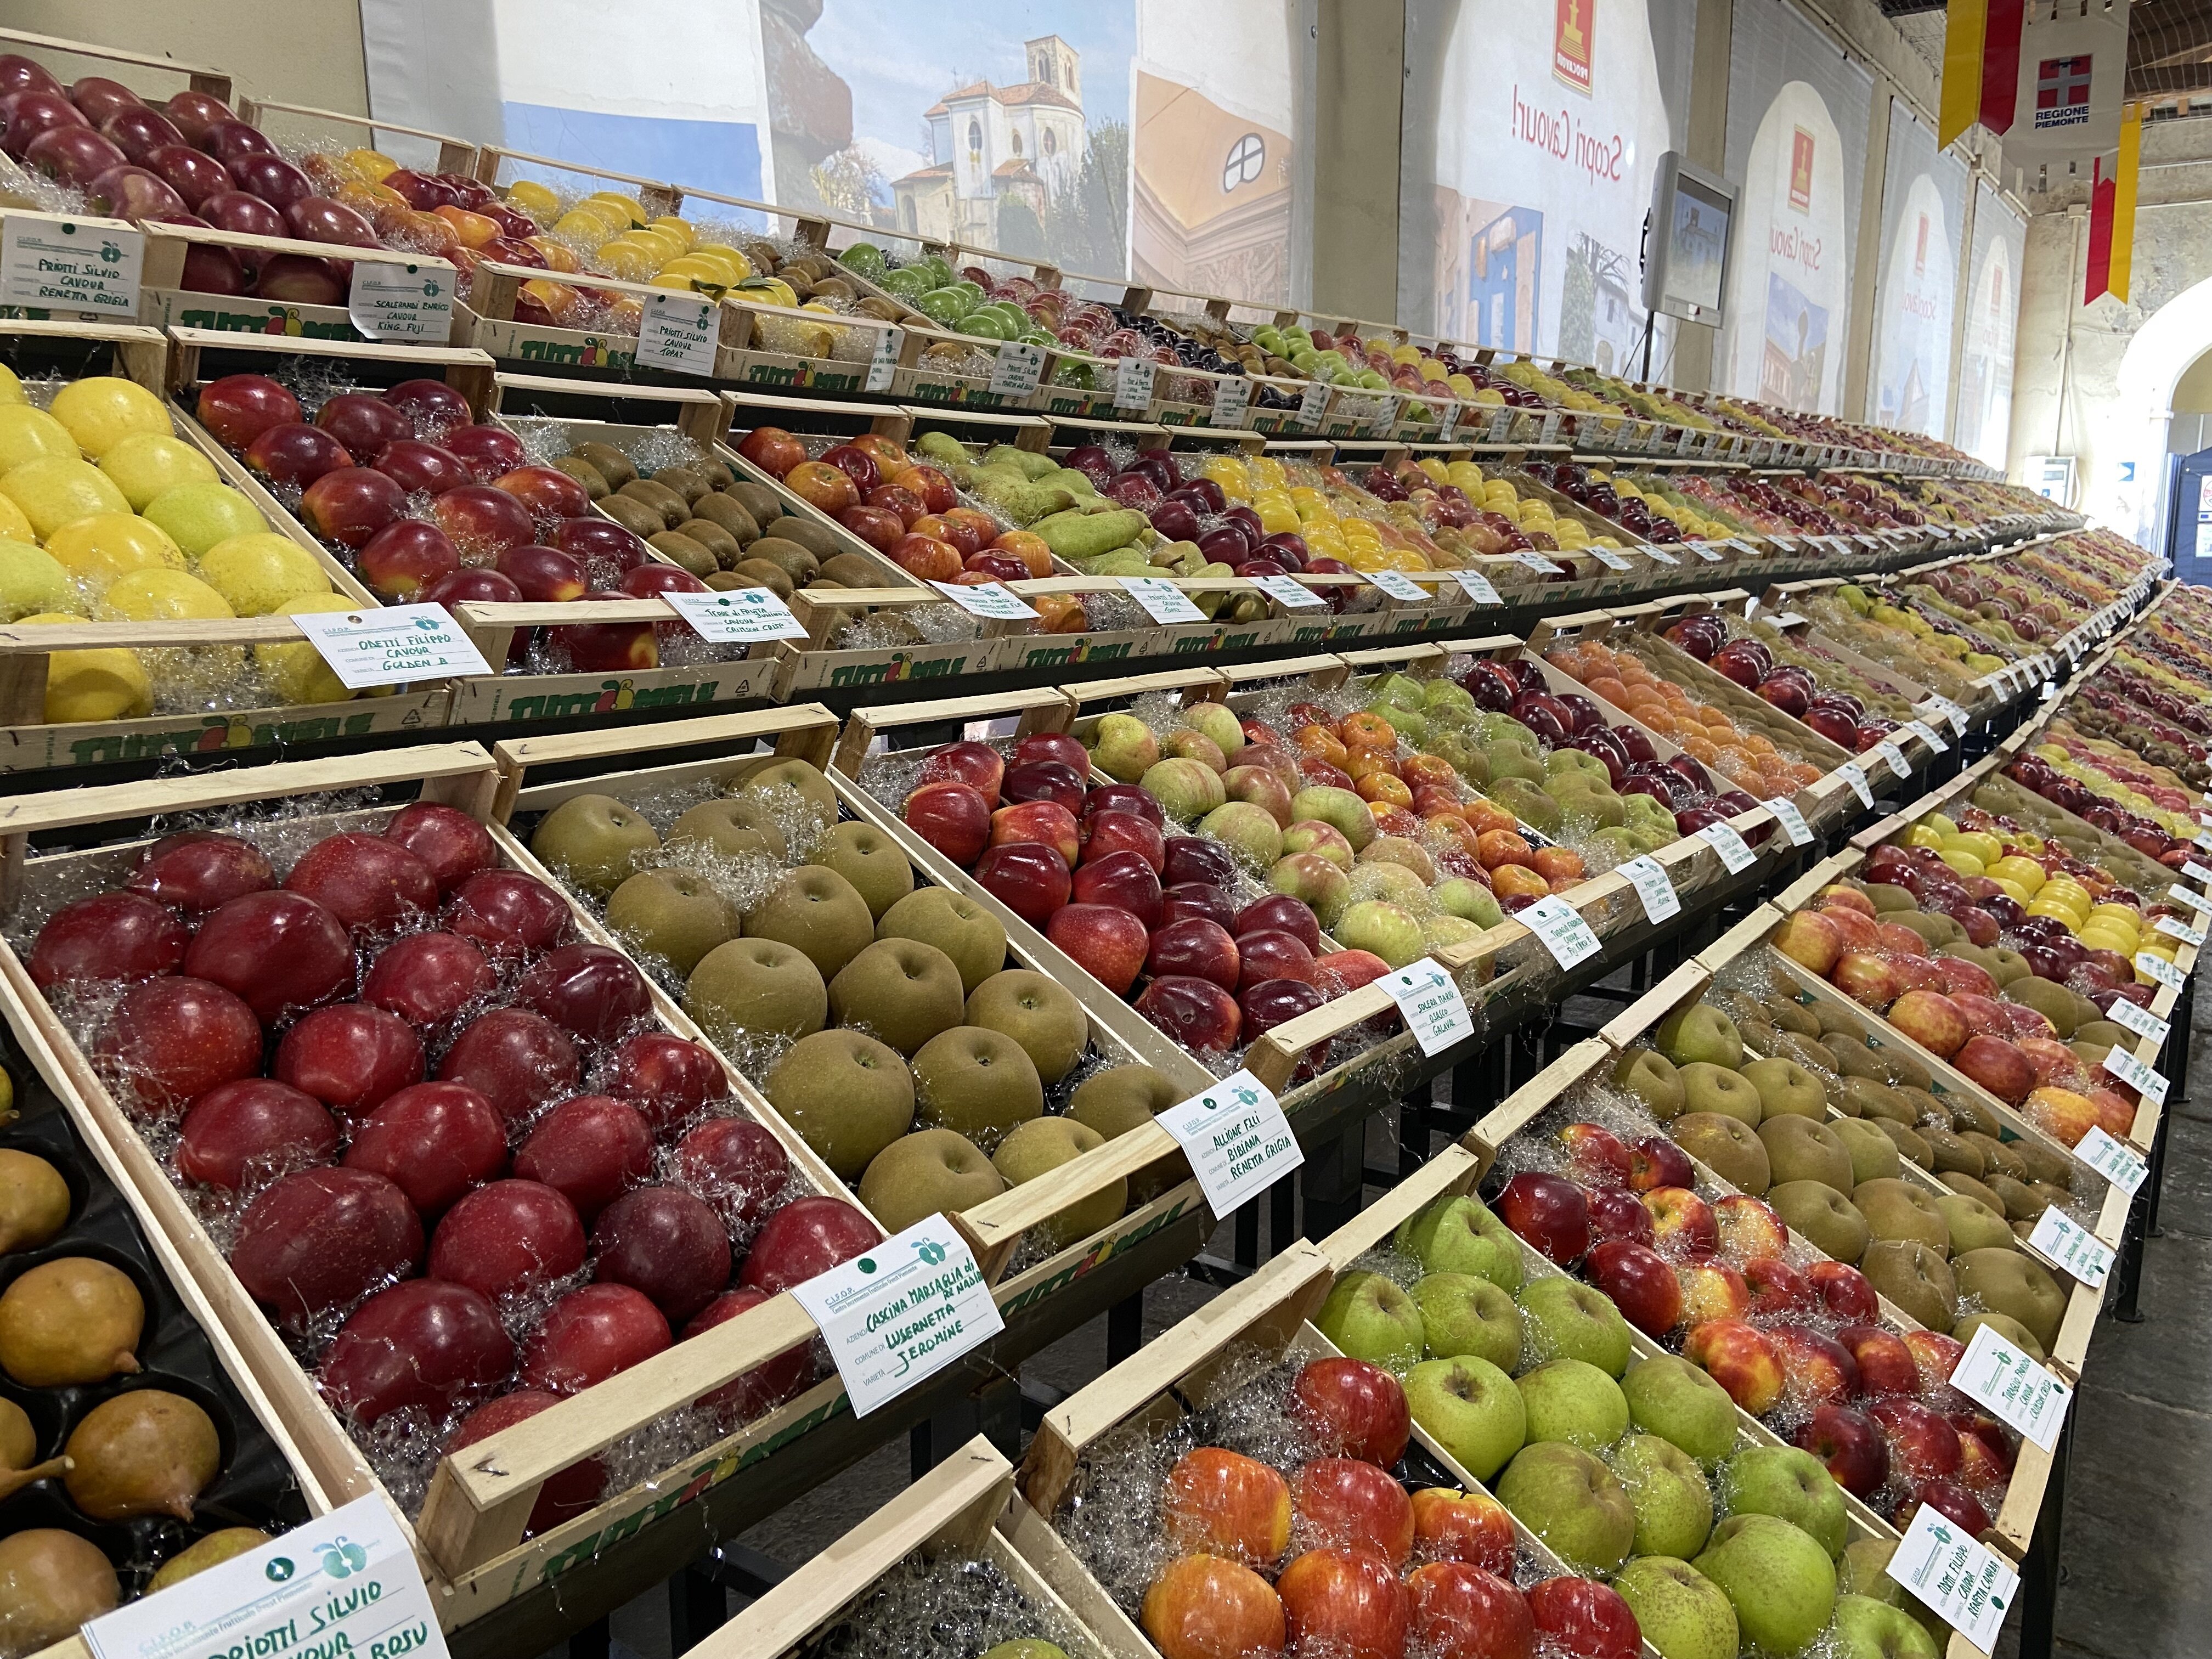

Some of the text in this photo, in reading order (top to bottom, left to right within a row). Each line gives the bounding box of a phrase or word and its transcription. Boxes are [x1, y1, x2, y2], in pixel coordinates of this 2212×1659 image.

[2035, 106, 2089, 121] REGIONE
[2035, 116, 2089, 129] PIEMONTE
[60, 275, 104, 290] CAVOUR
[39, 286, 88, 301] RENETTA
[377, 321, 400, 330] KING
[387, 312, 417, 321] CAVOUR
[664, 338, 691, 350] CAVOUR
[359, 637, 399, 651] ODETTI
[386, 646, 431, 658] CAVOUR
[437, 657, 448, 665] B
[1418, 999, 1437, 1013] SOLERA
[1438, 987, 1454, 1003] MARIO
[1212, 1124, 1242, 1150] ALLIONE
[1227, 1134, 1261, 1162] BIBIANA
[1230, 1136, 1291, 1180] RENETTA GRIGIA
[825, 1287, 855, 1306] C.I.F.O.P.
[866, 1299, 909, 1333] CASCINA
[907, 1267, 963, 1304] MARSAGLIA
[847, 1328, 868, 1345] AZIENDA
[885, 1304, 956, 1351] LUSERNETTA
[855, 1344, 886, 1365] COMUNE DI
[894, 1320, 964, 1379] JEROMINE
[1980, 1561, 2000, 1590] CANADA
[310, 1580, 382, 1635] SILVIO
